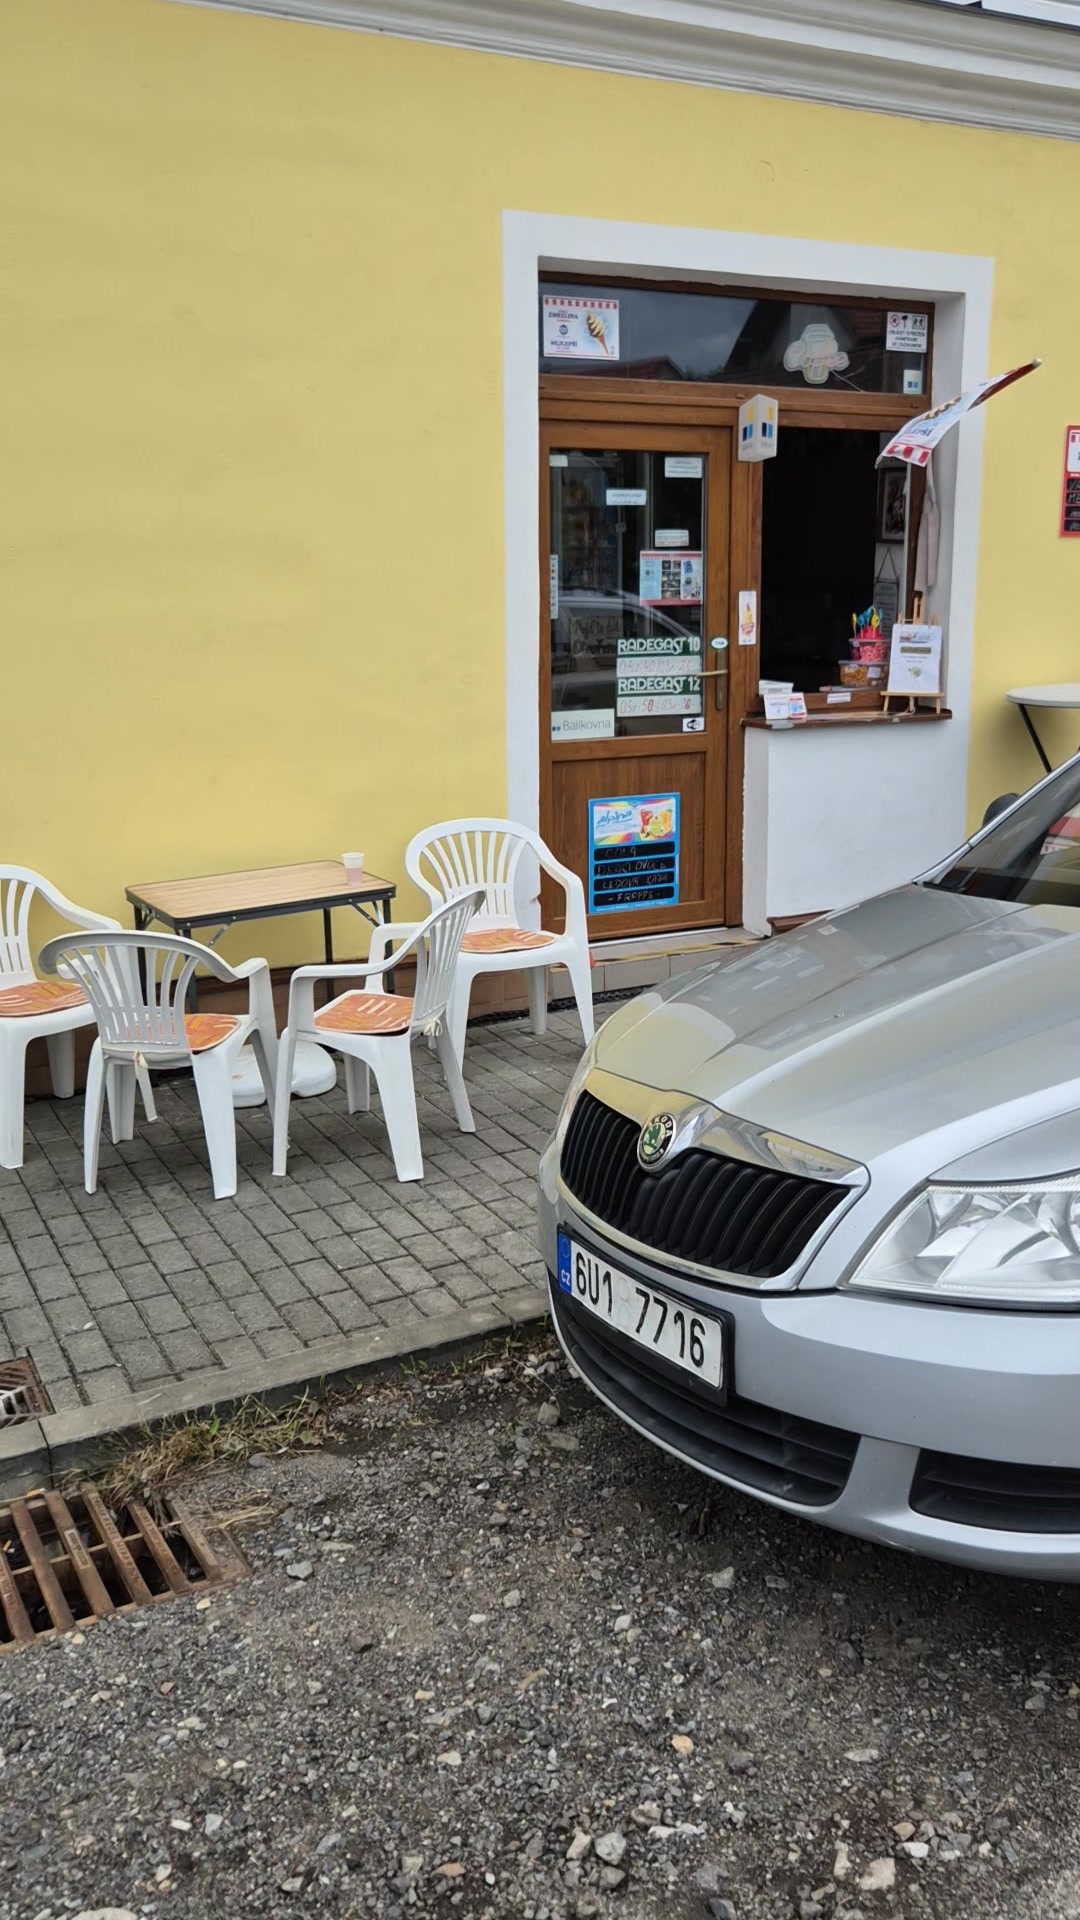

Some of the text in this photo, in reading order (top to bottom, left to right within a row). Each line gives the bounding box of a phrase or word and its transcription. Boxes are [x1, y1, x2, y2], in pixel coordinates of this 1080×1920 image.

[617, 637, 700, 655] RADEGAST 10
[618, 676, 700, 695] RADEGAST 12
[561, 1269, 571, 1286] CZ
[575, 1251, 706, 1368] 6U1 7716
